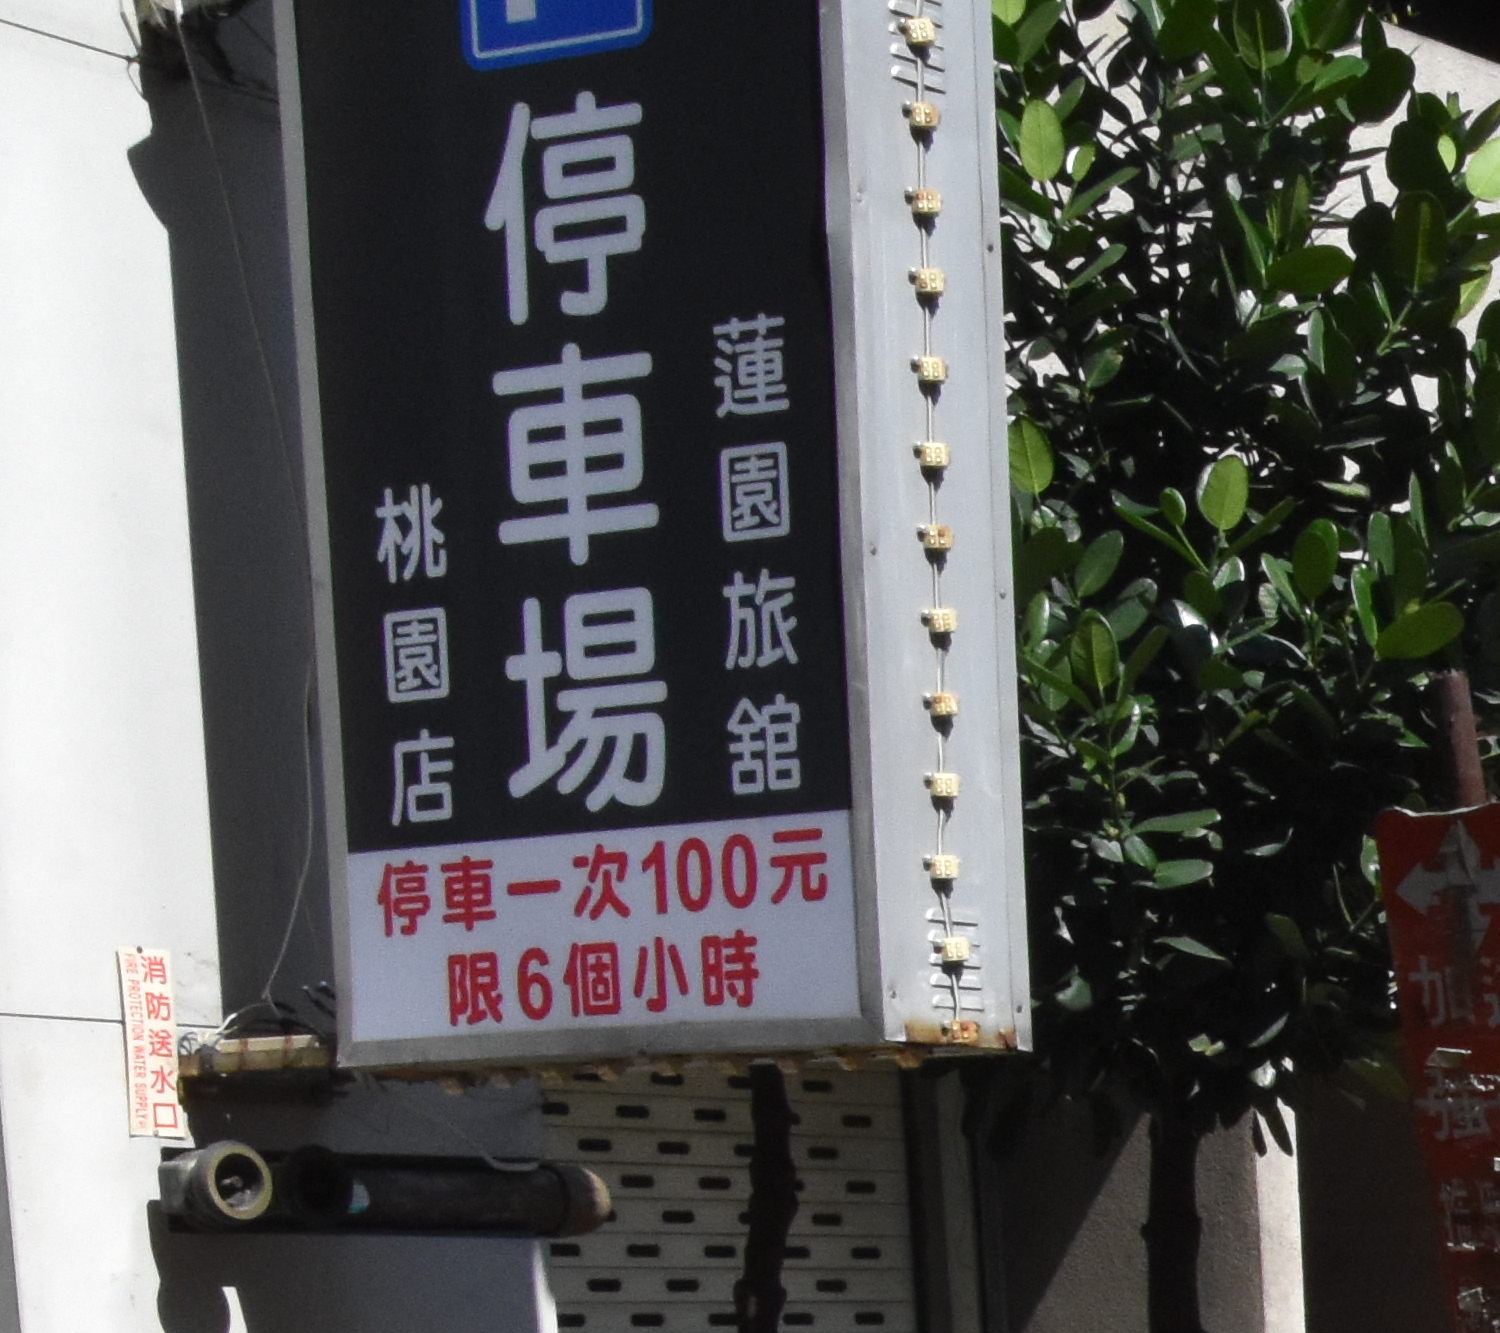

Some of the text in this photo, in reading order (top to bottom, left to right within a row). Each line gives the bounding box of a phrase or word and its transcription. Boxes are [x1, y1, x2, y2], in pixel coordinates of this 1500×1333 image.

[483, 90, 669, 813] 停車場
[375, 482, 455, 827] 桃園店
[375, 826, 828, 938] 停車一次100元
[124, 953, 149, 1120] FIRE PROTECTION WATER SUPPLY
[140, 955, 178, 1129] 消防送水口
[446, 933, 761, 1027] 限6個小時
